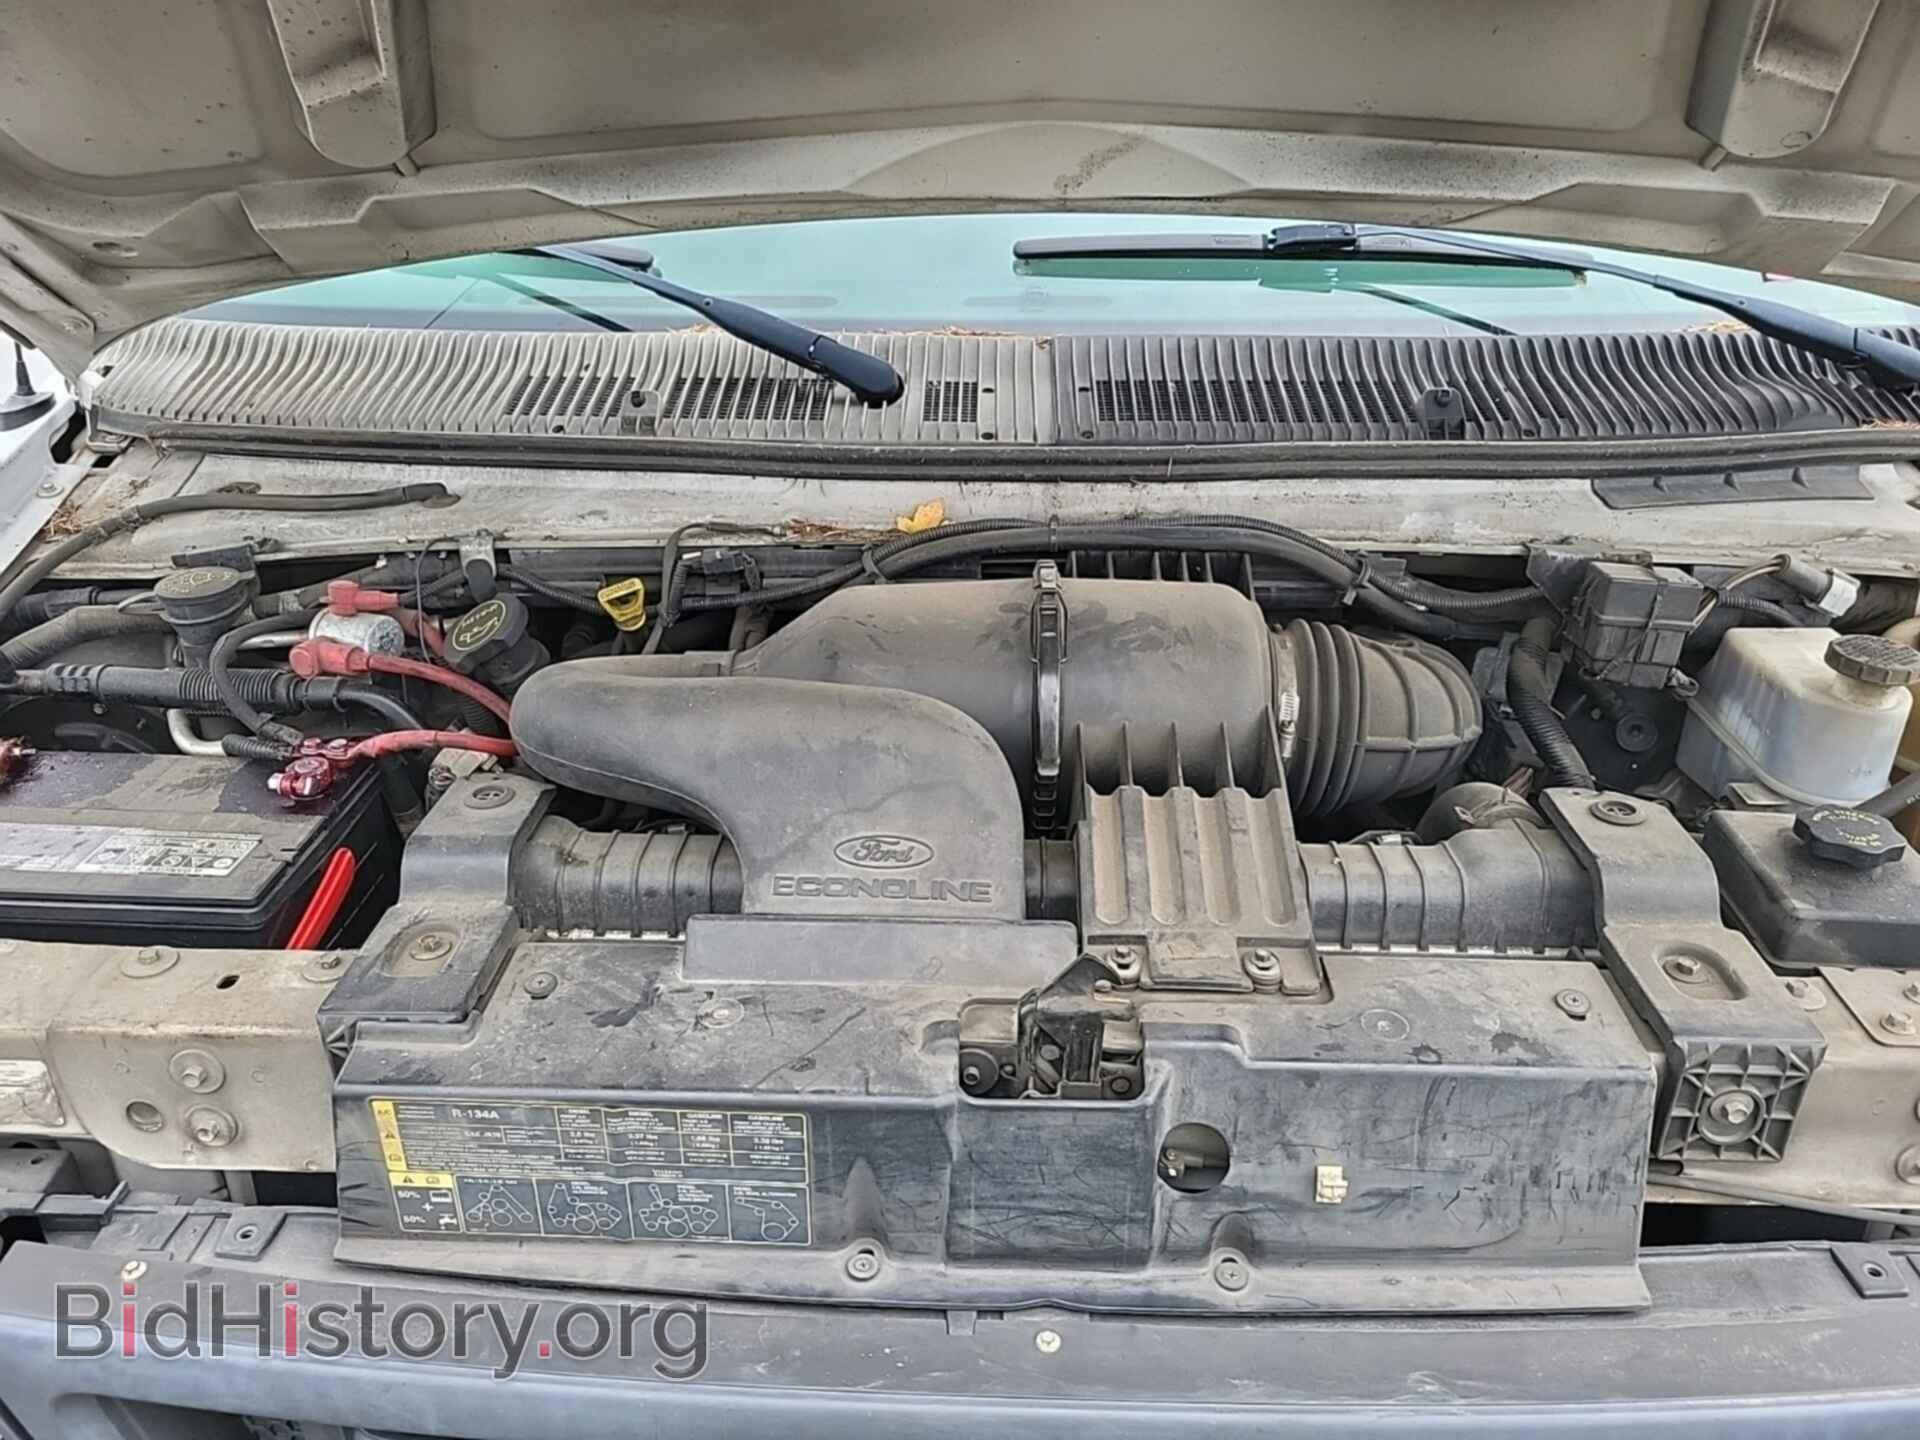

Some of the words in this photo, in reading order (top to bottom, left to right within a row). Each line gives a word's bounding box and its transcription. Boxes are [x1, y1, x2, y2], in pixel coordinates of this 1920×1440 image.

[853, 839, 914, 863] Ford
[773, 875, 993, 903] ECONOLINE
[451, 1108, 500, 1120] R-134A
[397, 1190, 422, 1199] 50%
[402, 1215, 427, 1224] 50%
